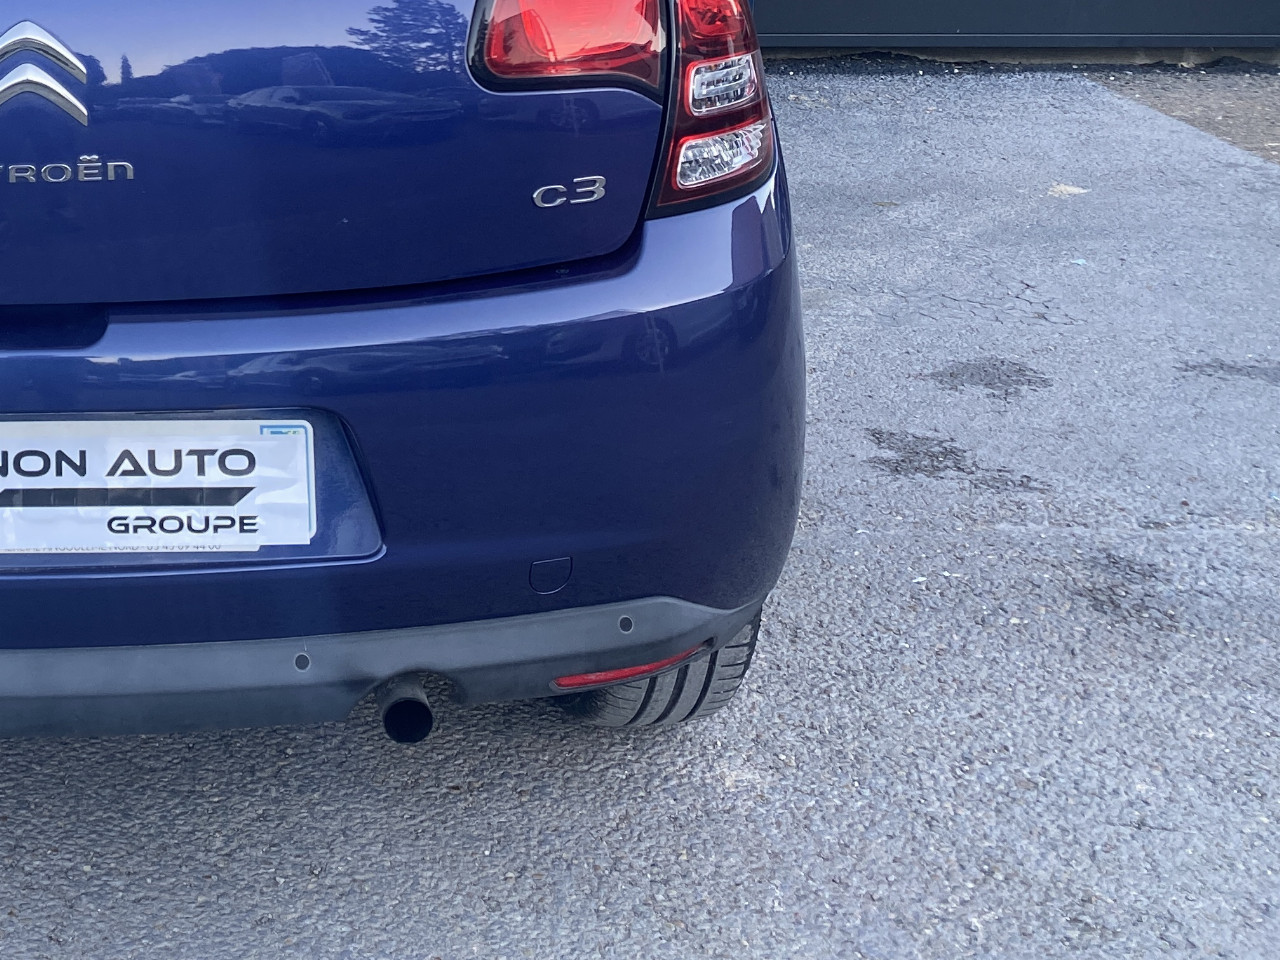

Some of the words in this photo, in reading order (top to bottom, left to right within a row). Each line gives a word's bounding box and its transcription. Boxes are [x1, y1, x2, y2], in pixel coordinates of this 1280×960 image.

[532, 176, 606, 208] C3
[102, 448, 257, 478] AUTO
[106, 515, 259, 534] GROUPE
